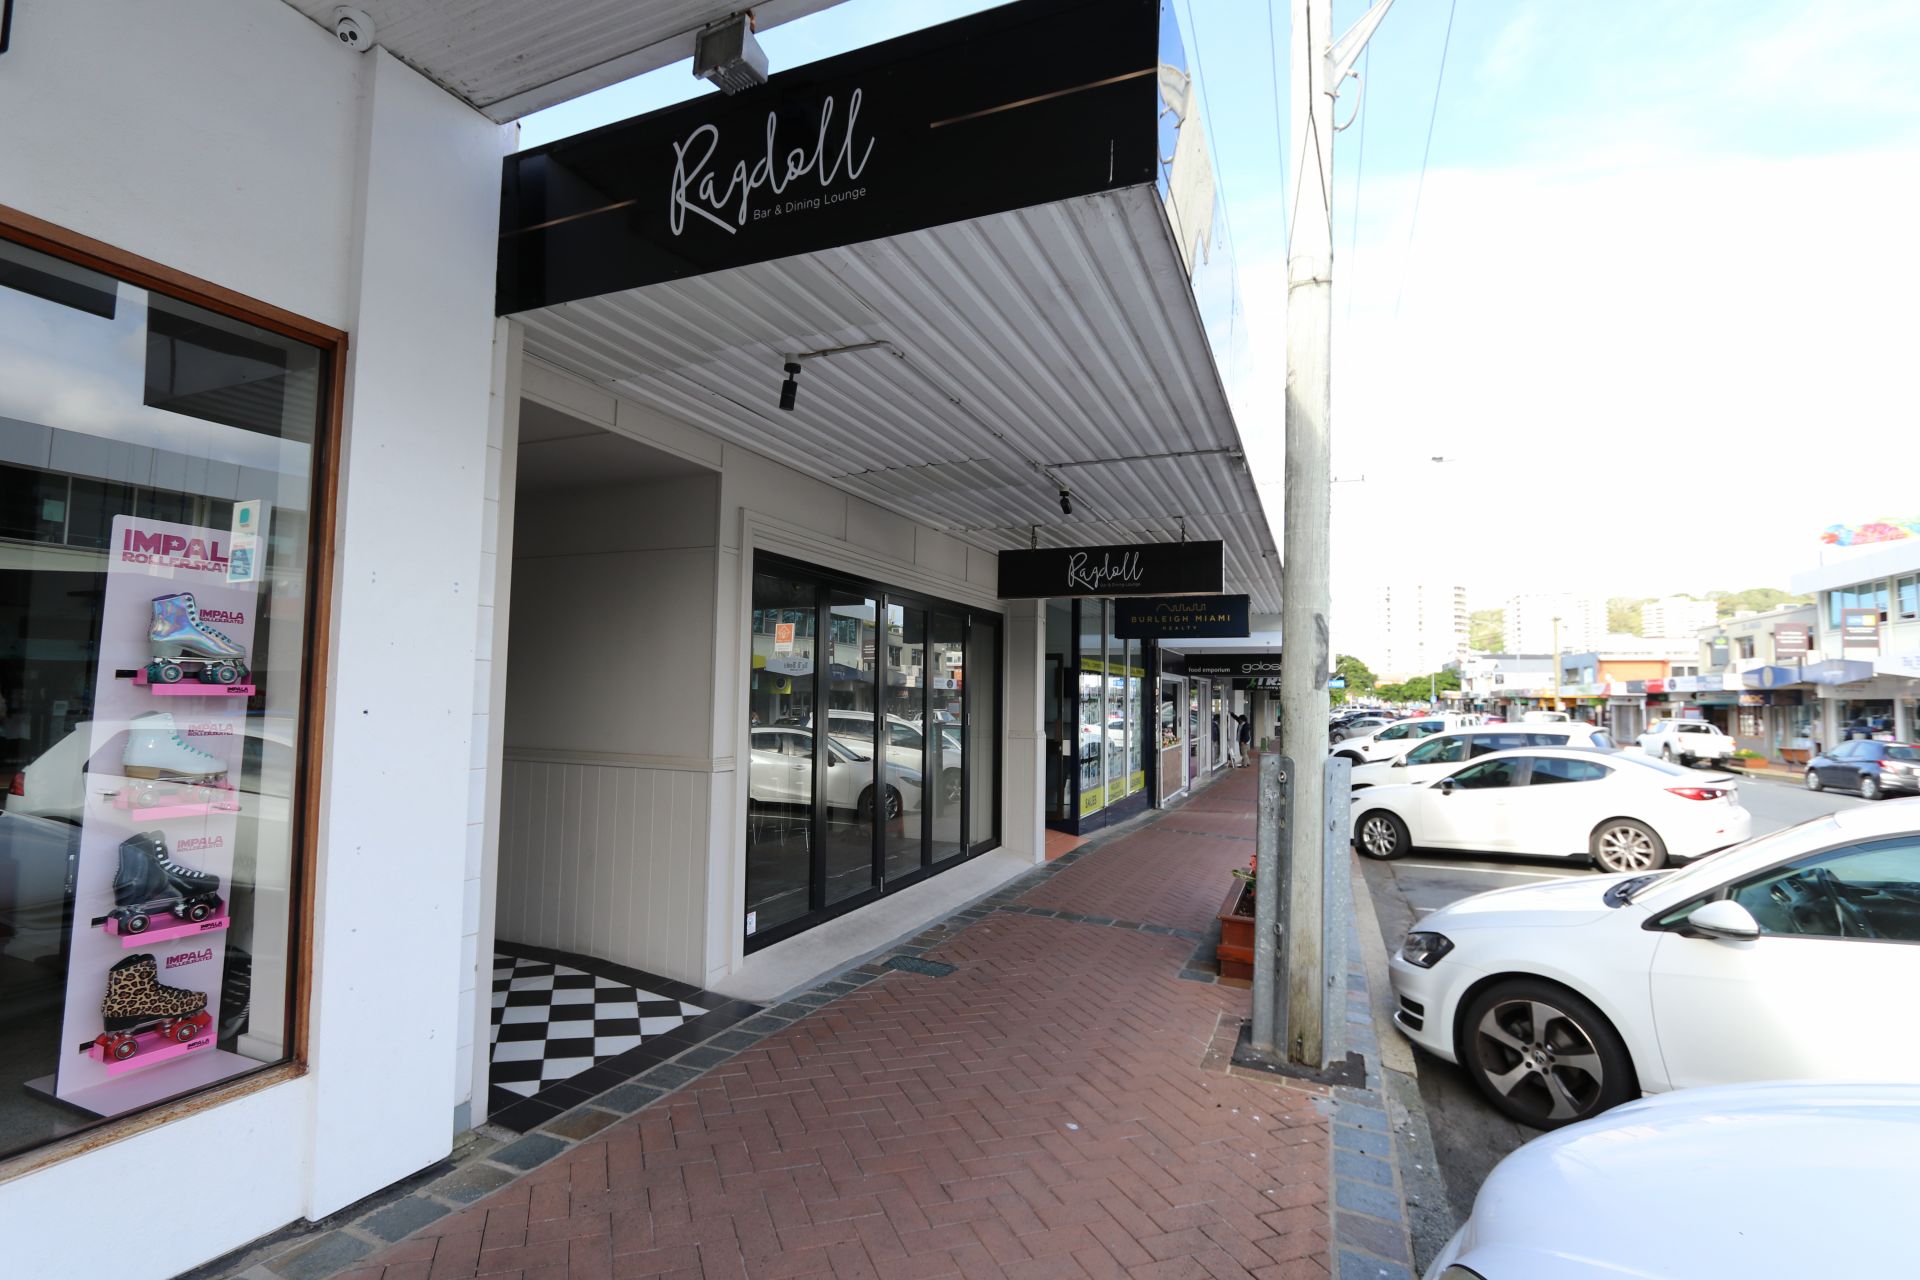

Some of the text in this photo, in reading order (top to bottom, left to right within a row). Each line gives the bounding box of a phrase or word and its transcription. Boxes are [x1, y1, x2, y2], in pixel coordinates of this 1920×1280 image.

[670, 87, 876, 236] Ragdoll
[753, 186, 867, 221] Bar & Dining Lounge
[1068, 551, 1144, 590] Ragdoll
[199, 609, 244, 622] IMPALA
[1131, 614, 1231, 623] BURLEIGH MIAMI
[1202, 666, 1231, 674] emporium
[1241, 660, 1281, 674] golos
[177, 835, 224, 849] IMPALA
[166, 948, 213, 966] IMPALA
